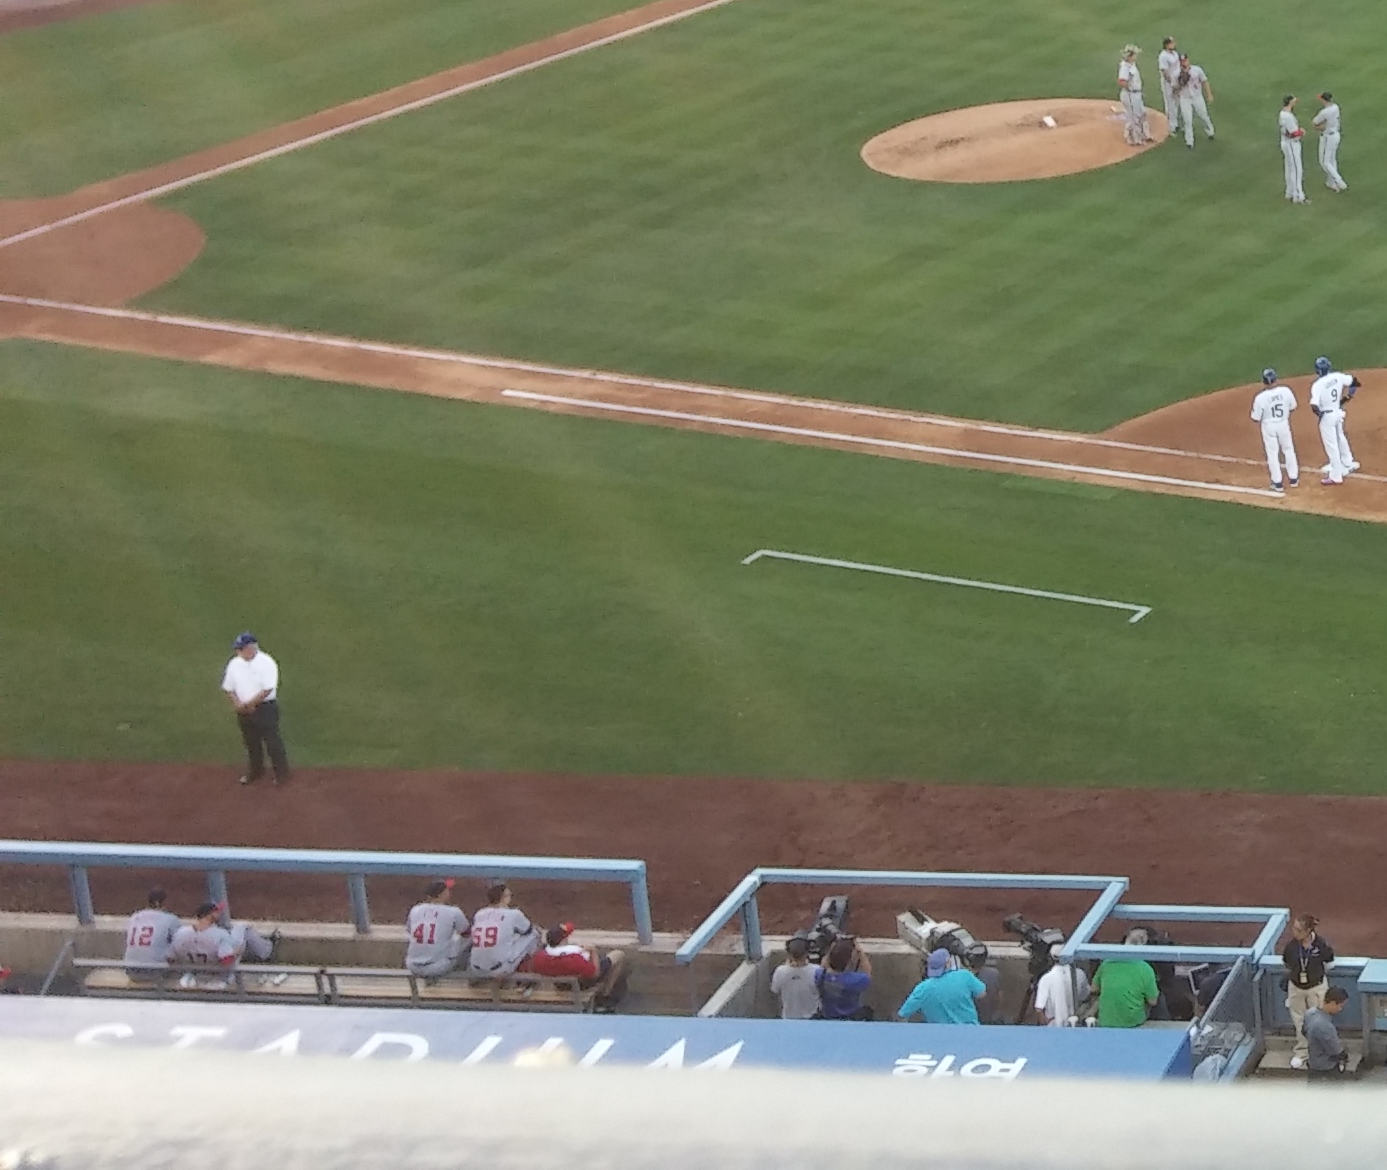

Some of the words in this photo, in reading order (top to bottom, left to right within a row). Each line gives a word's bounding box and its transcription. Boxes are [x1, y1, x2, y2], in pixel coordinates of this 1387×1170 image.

[1331, 389, 1338, 403] 9
[1271, 404, 1284, 418] 15
[129, 926, 154, 946] 12
[413, 923, 436, 945] 41
